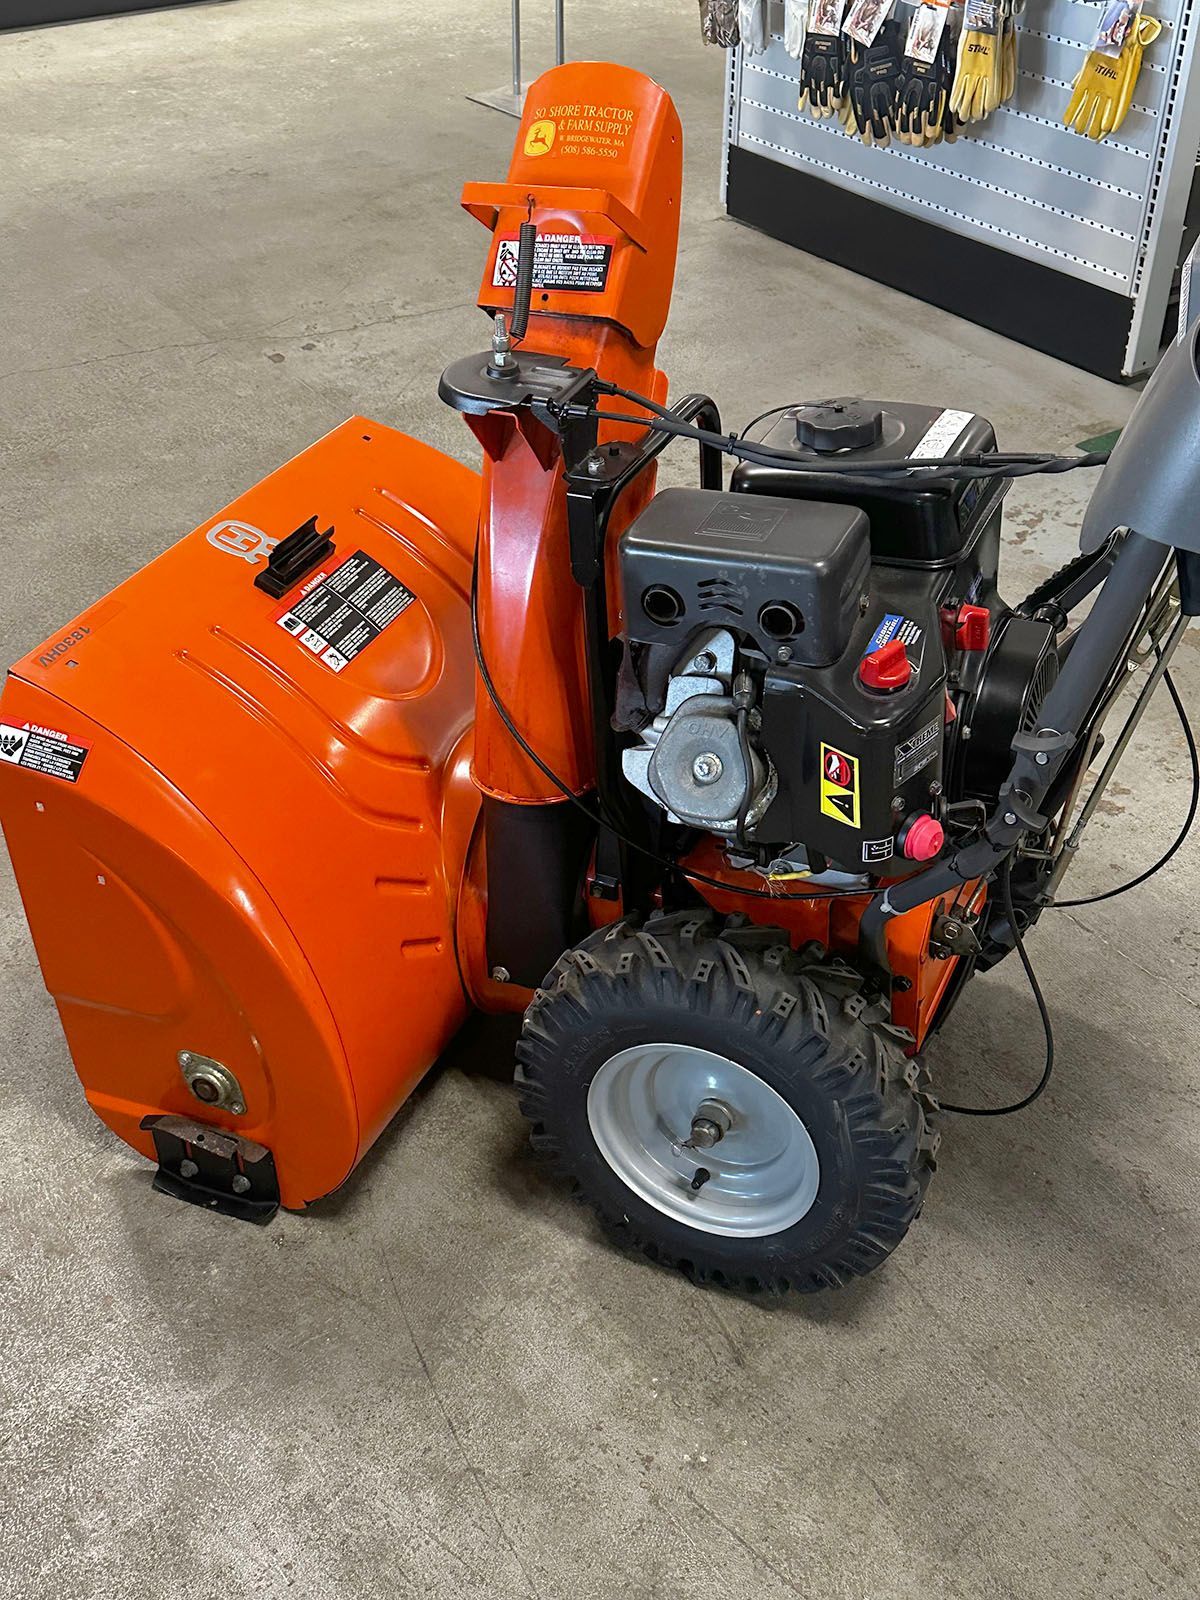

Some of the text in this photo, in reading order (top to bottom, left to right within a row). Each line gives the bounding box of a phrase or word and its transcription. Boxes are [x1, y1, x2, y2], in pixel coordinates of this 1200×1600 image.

[968, 44, 990, 55] STIHL
[1095, 64, 1119, 80] STIHL
[549, 105, 580, 117] SHORE
[584, 105, 634, 121] TRACTOR
[558, 119, 632, 136] & FARM SUPPLY
[614, 138, 625, 147] MA
[561, 145, 618, 158] (508) 586-5550
[544, 234, 581, 243] DANGER
[303, 571, 328, 593] DANGER
[875, 619, 892, 645] CHOKE
[879, 617, 900, 649] CONTROL
[39, 626, 91, 668] 1830HV
[30, 724, 68, 742] DANGER
